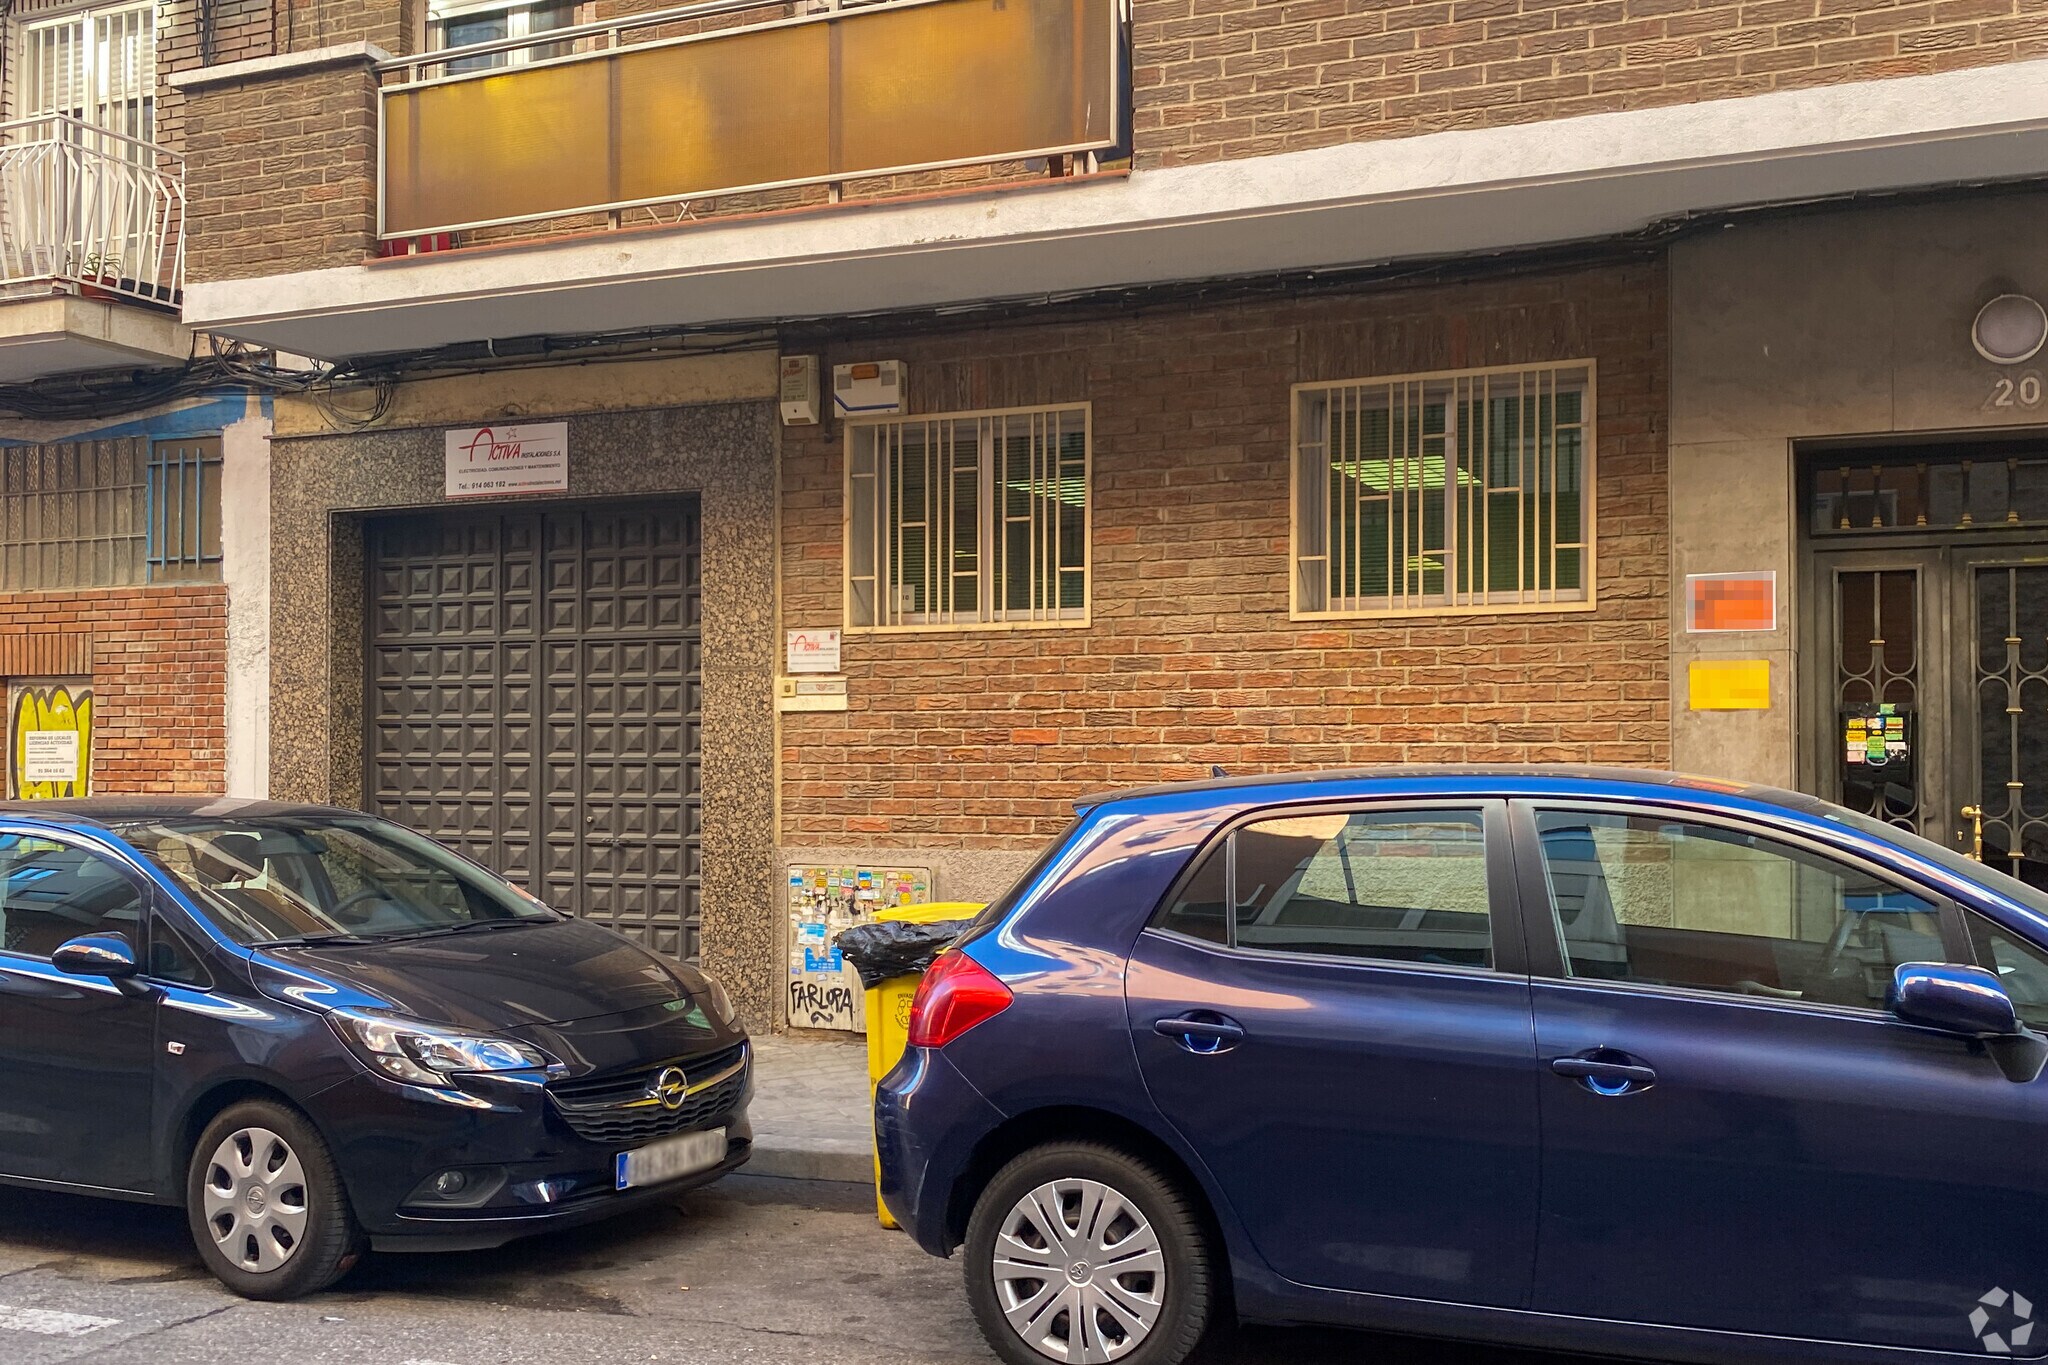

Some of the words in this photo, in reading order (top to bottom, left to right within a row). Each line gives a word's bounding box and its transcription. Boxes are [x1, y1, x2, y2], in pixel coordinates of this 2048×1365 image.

[1996, 377, 2040, 406] 20
[459, 427, 521, 461] ACTIVA
[790, 981, 853, 1021] FARLOPA
